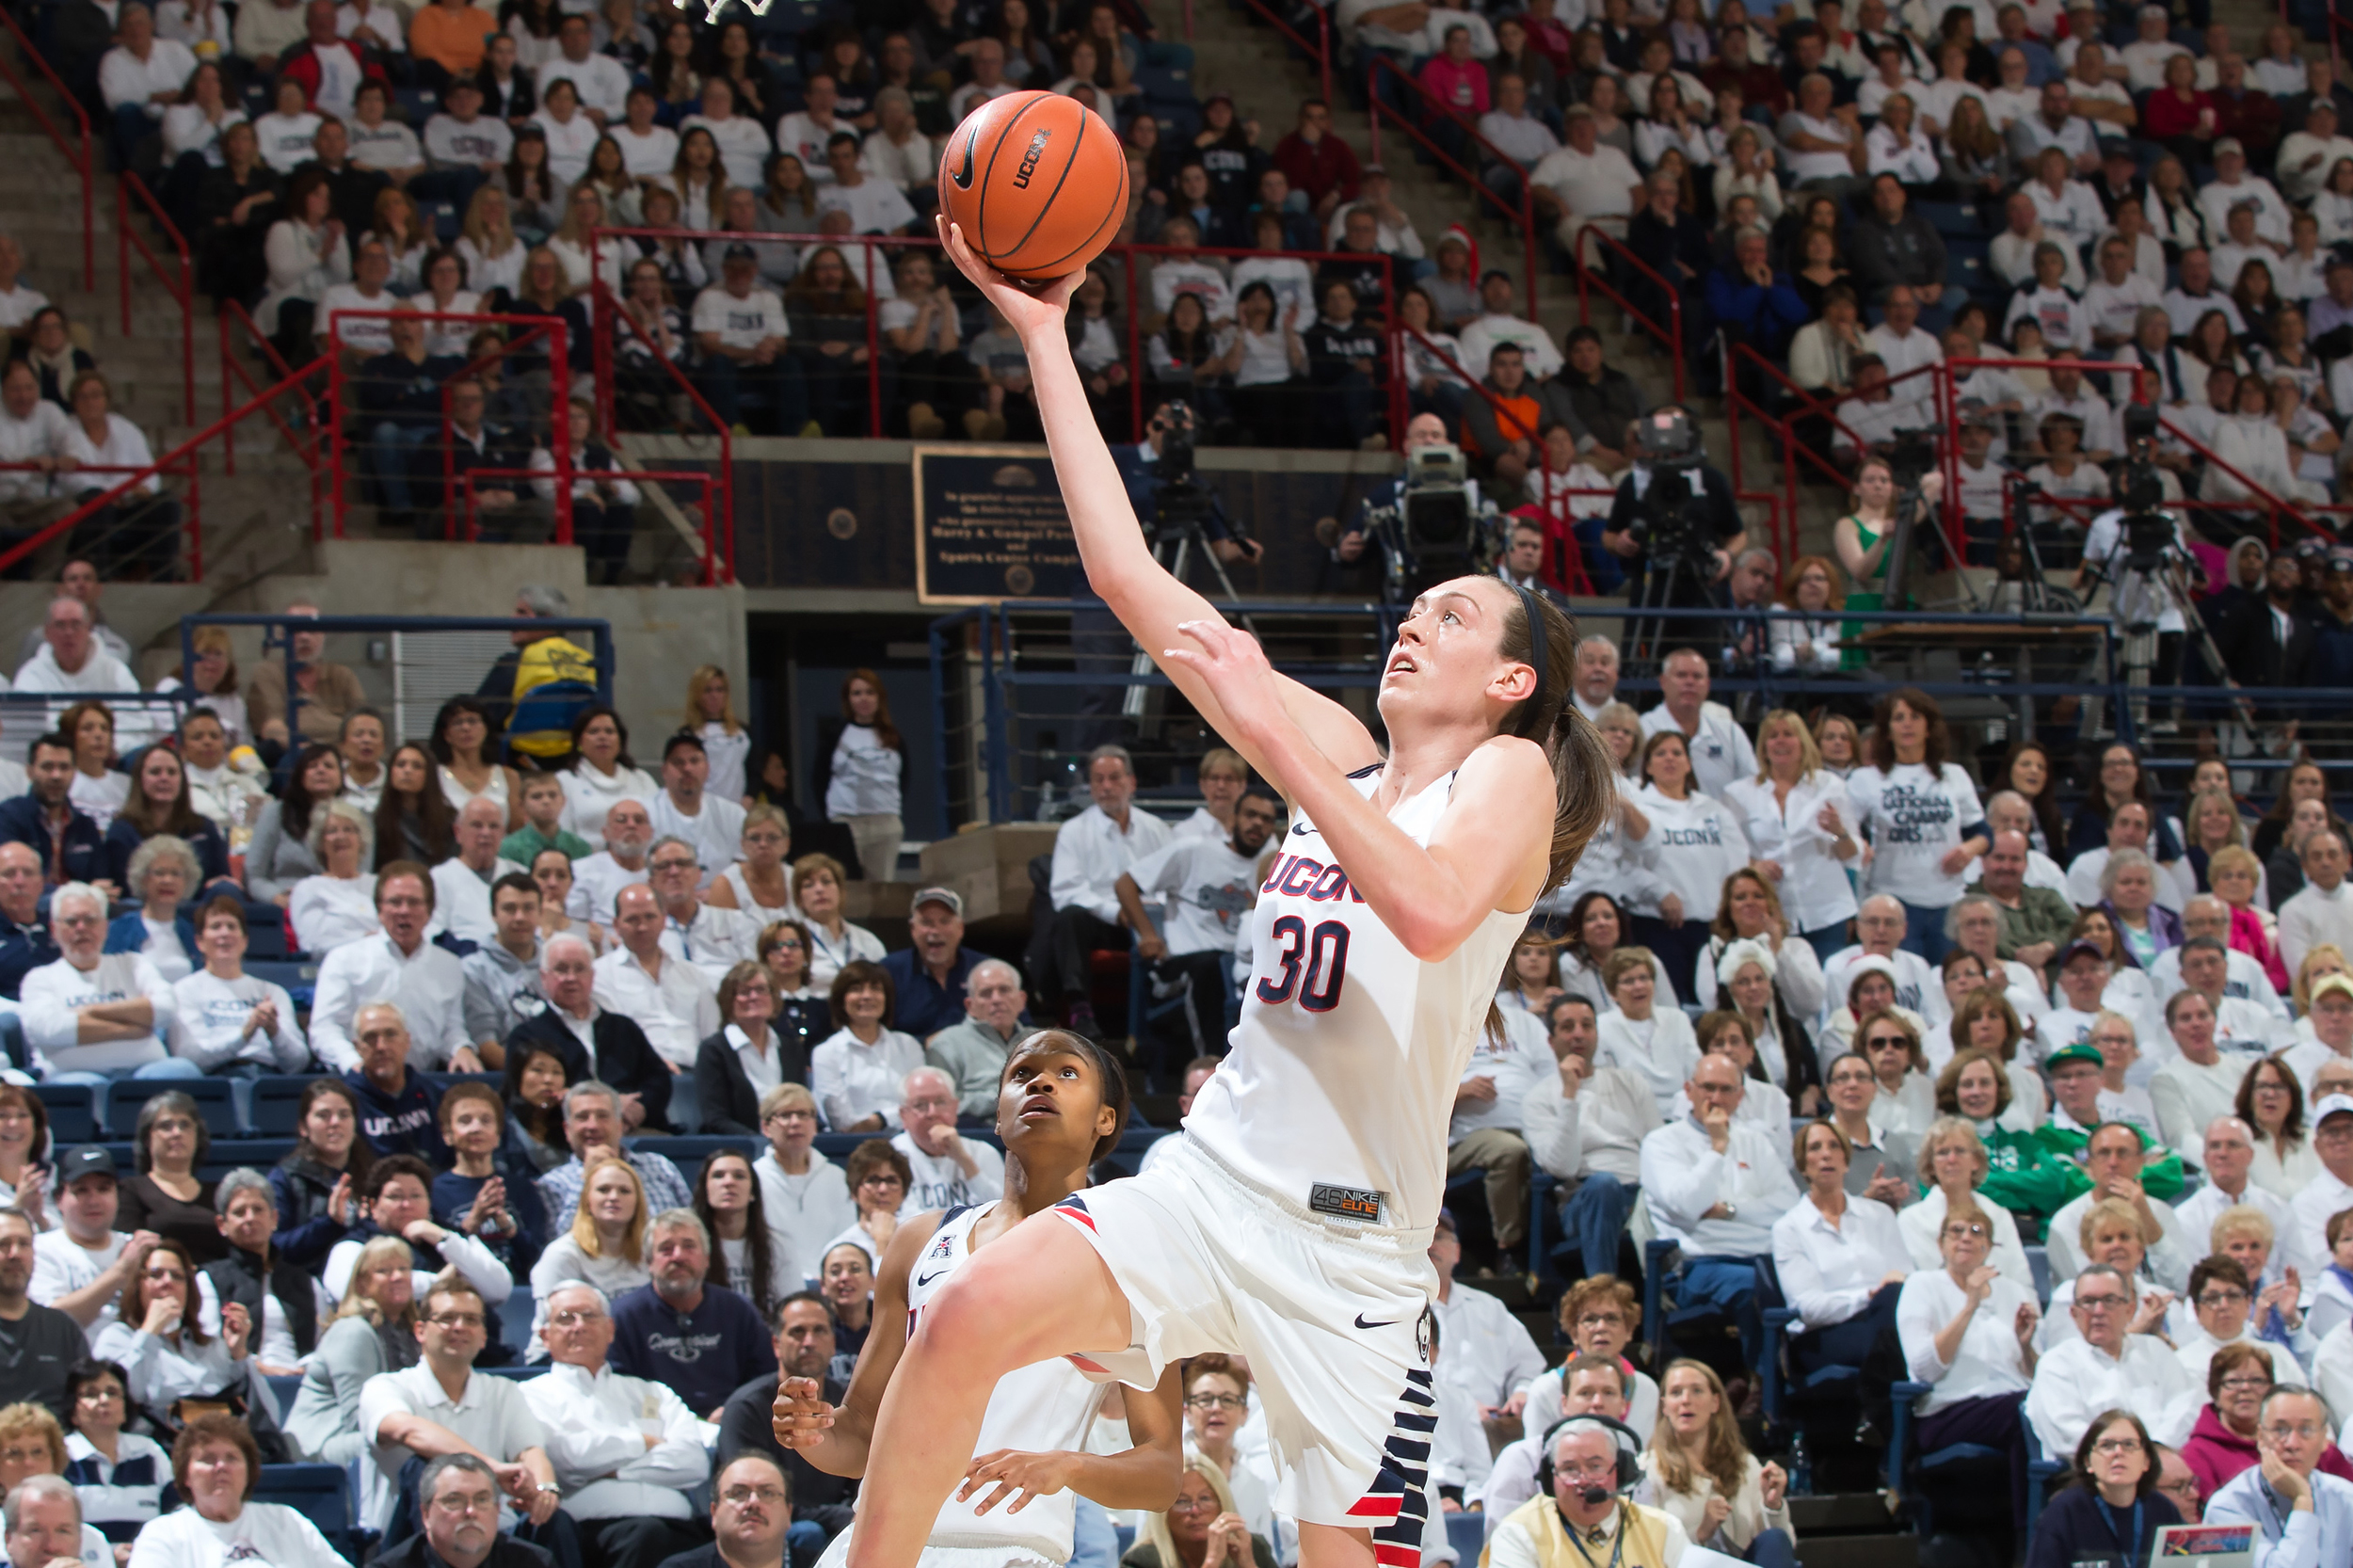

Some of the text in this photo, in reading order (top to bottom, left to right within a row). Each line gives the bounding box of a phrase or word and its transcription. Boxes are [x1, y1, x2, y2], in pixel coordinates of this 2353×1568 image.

[1262, 853, 1368, 904] UCON
[1256, 914, 1352, 1013] 30
[1313, 1188, 1380, 1206] 46 NIKE
[1341, 1198, 1379, 1215] ELITE
